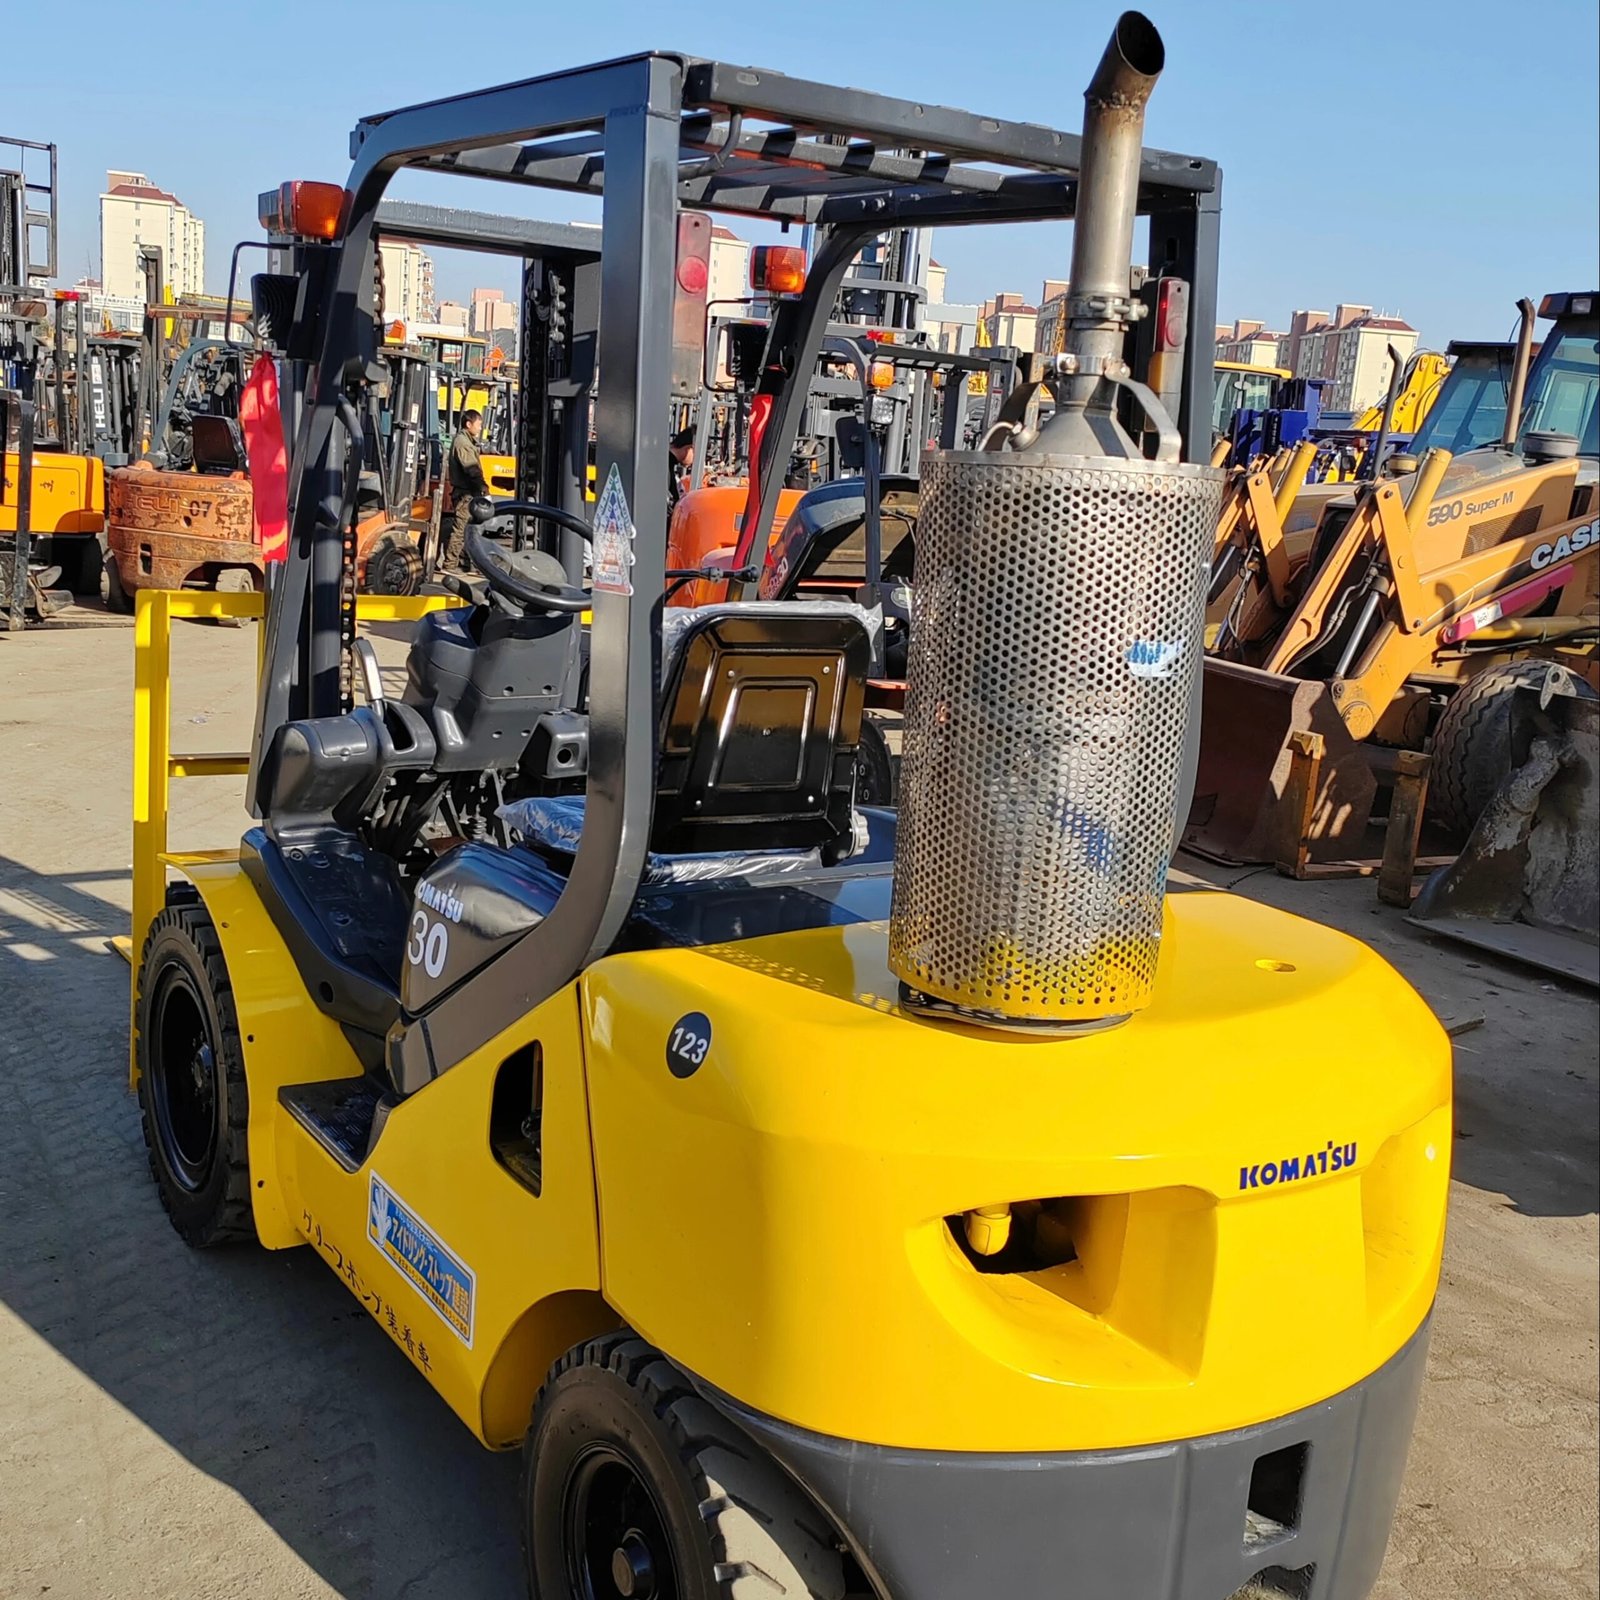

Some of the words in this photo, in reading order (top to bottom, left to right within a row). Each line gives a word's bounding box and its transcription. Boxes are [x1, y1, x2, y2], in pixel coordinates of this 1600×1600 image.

[92, 388, 106, 428] HELI
[404, 429, 417, 473] HELI
[189, 500, 213, 518] 07
[1427, 500, 1463, 527] 590
[1465, 497, 1500, 516] Super
[1503, 491, 1514, 505] M
[407, 910, 448, 979] 30
[671, 1027, 708, 1064] 123
[1239, 1140, 1357, 1190] KOMATSU
